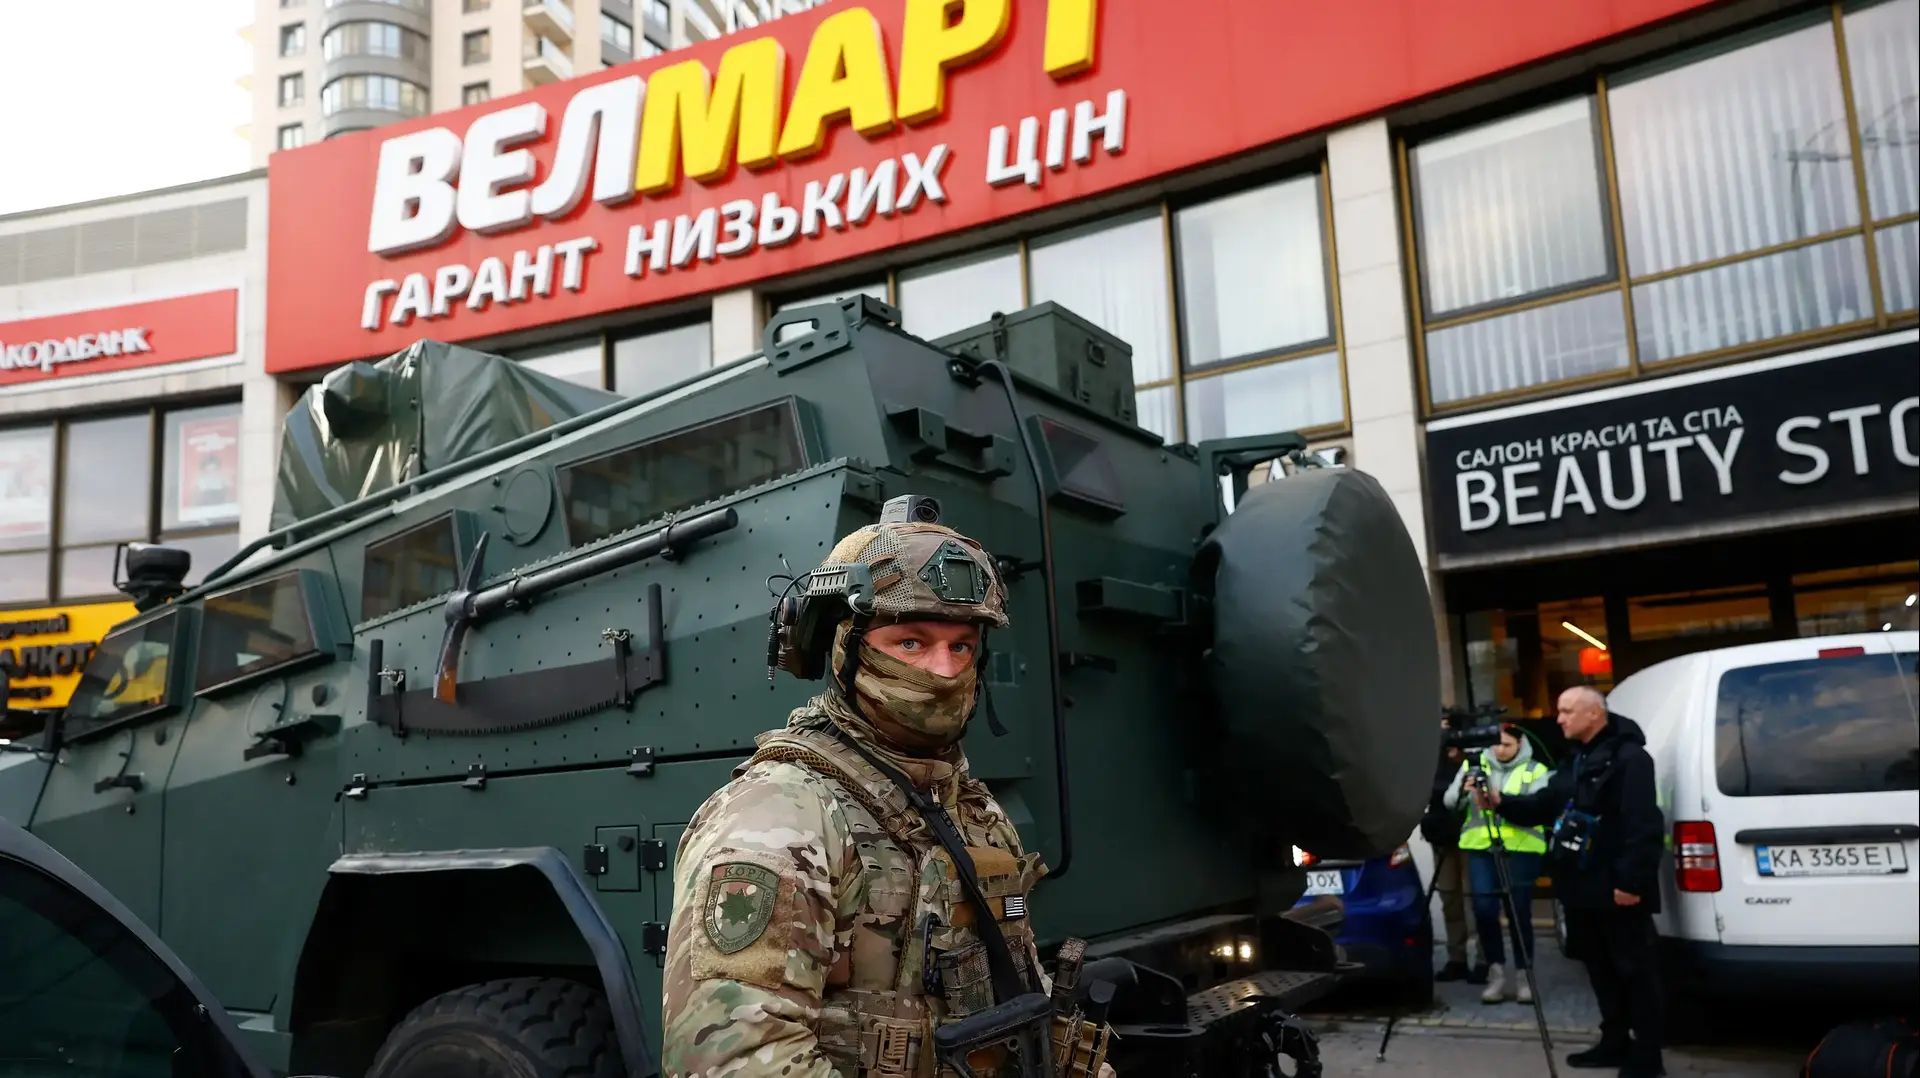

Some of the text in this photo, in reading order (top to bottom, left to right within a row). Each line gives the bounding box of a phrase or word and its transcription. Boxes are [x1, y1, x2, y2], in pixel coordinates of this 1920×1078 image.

[361, 89, 1126, 330] ГАРАНТ НИЗЬКИХ ЦІН
[1456, 404, 1744, 470] САЛОН КРАСИ ТА СПА
[1456, 427, 1744, 531] BEAUTY
[723, 866, 767, 881] КОРД
[1772, 848, 1804, 868] KA
[1808, 847, 1860, 867] 3365
[1745, 897, 1792, 905] CADDY
